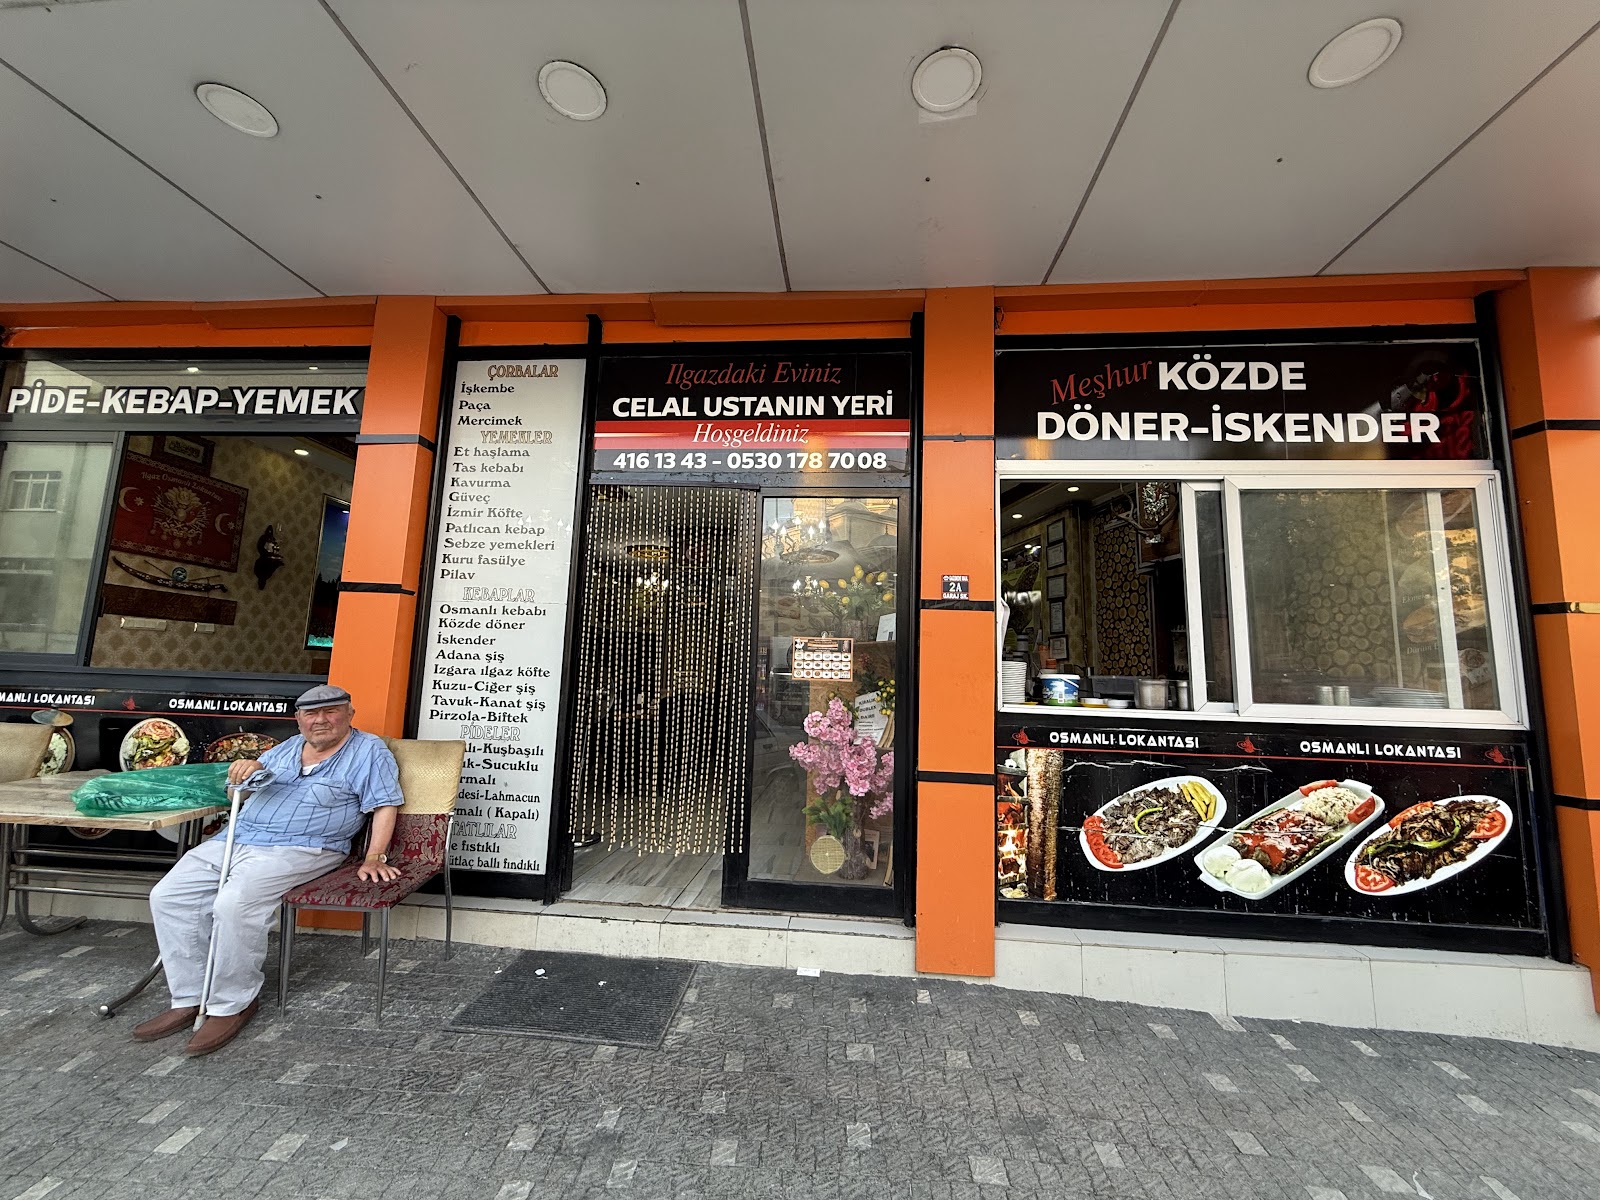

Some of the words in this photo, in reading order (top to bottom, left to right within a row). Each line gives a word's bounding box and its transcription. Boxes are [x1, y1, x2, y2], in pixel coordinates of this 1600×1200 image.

[488, 364, 558, 380] ÇORBALAR
[666, 362, 766, 390] Ilgazdaki
[772, 362, 842, 384] Eviniz
[1158, 354, 1306, 391] KÖZDE
[460, 381, 514, 395] İşkembe
[1049, 360, 1153, 406] Meşhur
[7, 380, 358, 414] PİDE-KEBAP-YEMEK
[612, 397, 696, 418] CELAL
[704, 396, 824, 417] USTANIN
[832, 390, 893, 416] YERİ
[458, 400, 491, 412] Paça
[457, 416, 522, 426] Mercimek
[1036, 404, 1441, 443] DÖNER-İSKENDER
[480, 430, 552, 444] YEMEKLER
[692, 423, 810, 448] Hoşgeldiniz
[454, 446, 470, 456] Et
[474, 447, 530, 458] haşlama
[453, 462, 476, 472] Tas
[480, 462, 524, 472] kebabı
[613, 452, 650, 469] 416
[654, 453, 676, 469] 13
[680, 453, 707, 469] 43
[727, 452, 782, 470] 0530
[786, 452, 822, 470] 178
[828, 452, 854, 470] 70
[858, 452, 887, 469] 08
[450, 478, 511, 488] Kavurma
[448, 492, 490, 504] Güveç
[447, 504, 484, 518] İzmir
[487, 508, 523, 518] Köfte
[445, 522, 500, 534] Patlıcan
[505, 524, 545, 536] kebap
[444, 538, 486, 548] Sebze
[489, 540, 555, 550] yemekleri
[442, 554, 473, 564] Kuru
[478, 554, 526, 567] fasülye
[440, 568, 476, 580] Pilav
[949, 582, 962, 592] 2A
[463, 587, 536, 602] KEBAPLAR
[440, 604, 496, 615] Osmanlı
[502, 605, 546, 616] kebabı
[438, 618, 481, 628] Közde
[486, 619, 526, 630] döner
[436, 632, 496, 645] İskender
[435, 650, 480, 660] Adana
[485, 651, 504, 663] şiş
[434, 664, 476, 676] Izgara
[480, 666, 512, 678] ılgaz
[517, 667, 550, 678] köfte
[432, 680, 512, 694] Kuzu-Ciğer
[516, 683, 536, 695] şiş
[34, 694, 96, 705] LOKANTASI
[168, 698, 220, 710] OSMANLI
[224, 700, 287, 712] LOKANTASI
[431, 694, 522, 708] Tavuk-Kanat
[526, 700, 546, 711] şiş
[429, 709, 528, 723] Pirzola-Biftek
[460, 722, 520, 741] PİDELER
[1050, 732, 1114, 745] OSMANLI
[1118, 734, 1199, 748] LOKANTASI
[464, 743, 544, 758] lı-Kuşbaşılı
[1300, 741, 1370, 754] OSMANLI
[1374, 744, 1462, 758] LOKANTASI
[460, 774, 496, 785] rmalı
[457, 790, 540, 802] desi-Lahmacun
[462, 840, 500, 853] fıstıklı
[450, 855, 474, 868] ütlaç
[478, 856, 500, 868] ballı
[504, 858, 540, 871] fındıklı
